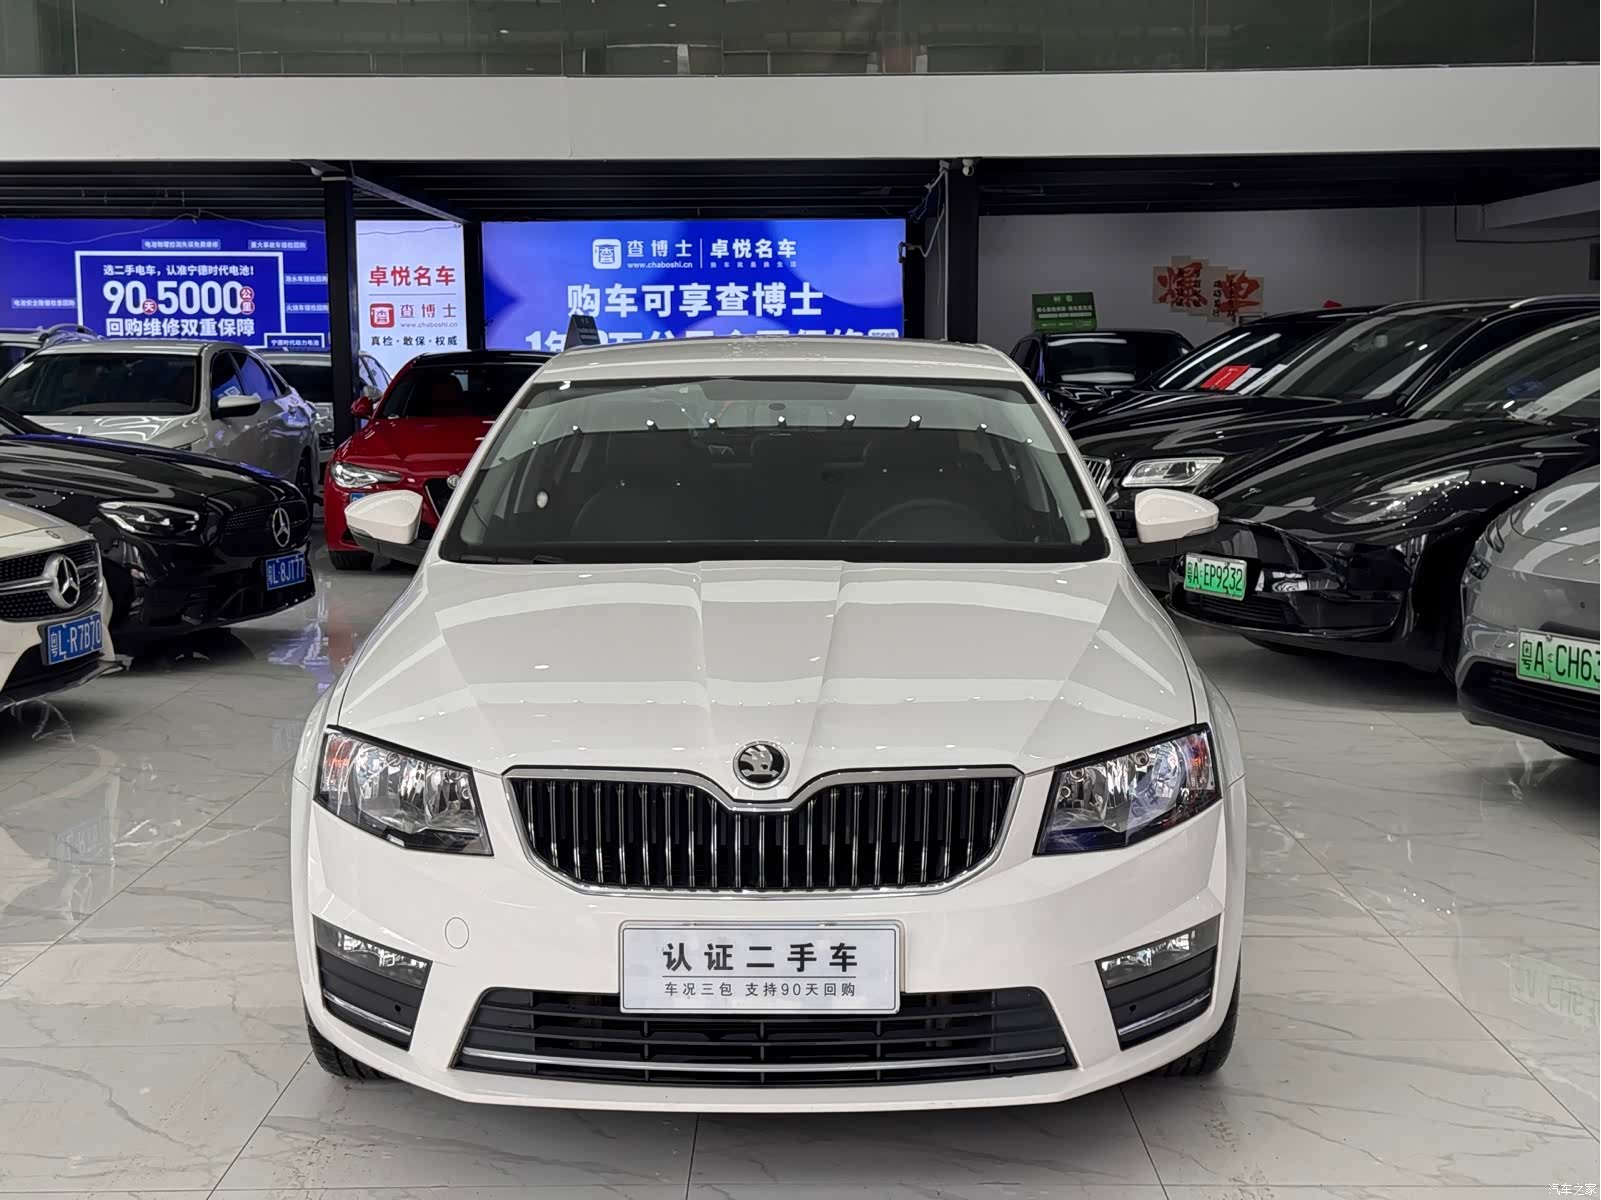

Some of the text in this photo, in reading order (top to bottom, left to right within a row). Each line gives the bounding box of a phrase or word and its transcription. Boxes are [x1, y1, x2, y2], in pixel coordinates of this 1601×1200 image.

[627, 240, 693, 257] 查博士
[710, 238, 797, 259] 卓悦名车
[368, 266, 456, 287] 卓悦名车
[400, 303, 457, 318] 查博士
[567, 283, 823, 318] 购车可享查博士
[106, 318, 256, 337] 回购维修双重保障
[662, 942, 858, 972] 认证二手车
[664, 982, 855, 997] 车况三包 支持90天回购
